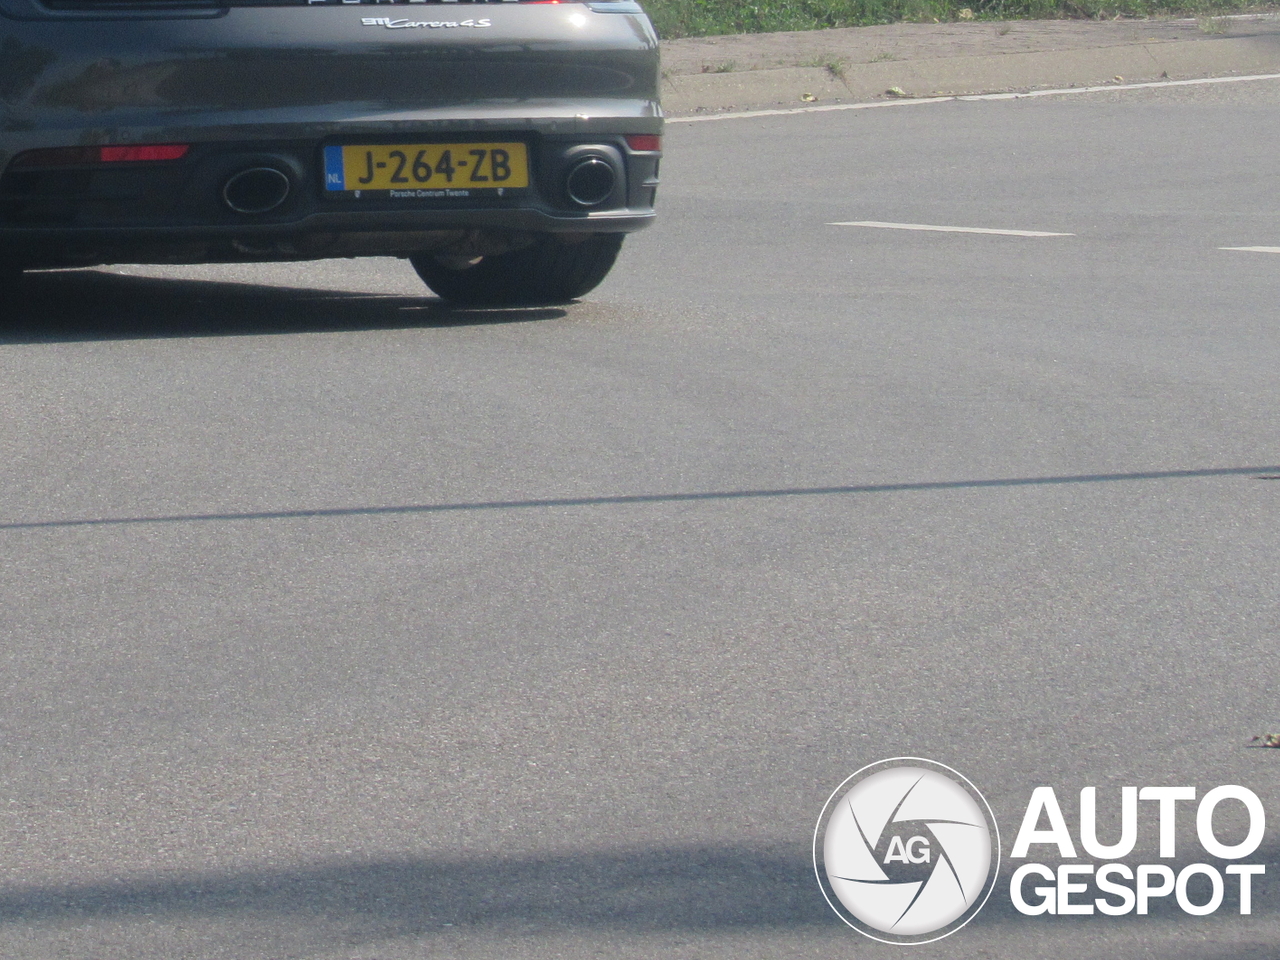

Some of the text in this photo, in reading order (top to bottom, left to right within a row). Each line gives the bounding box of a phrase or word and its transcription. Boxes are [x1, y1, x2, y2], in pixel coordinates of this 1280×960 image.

[361, 17, 389, 26] 911
[386, 18, 459, 29] Carrera
[358, 149, 511, 184] J-264-ZB
[328, 173, 341, 183] NL
[390, 189, 469, 197] Porsche Centrum Twente
